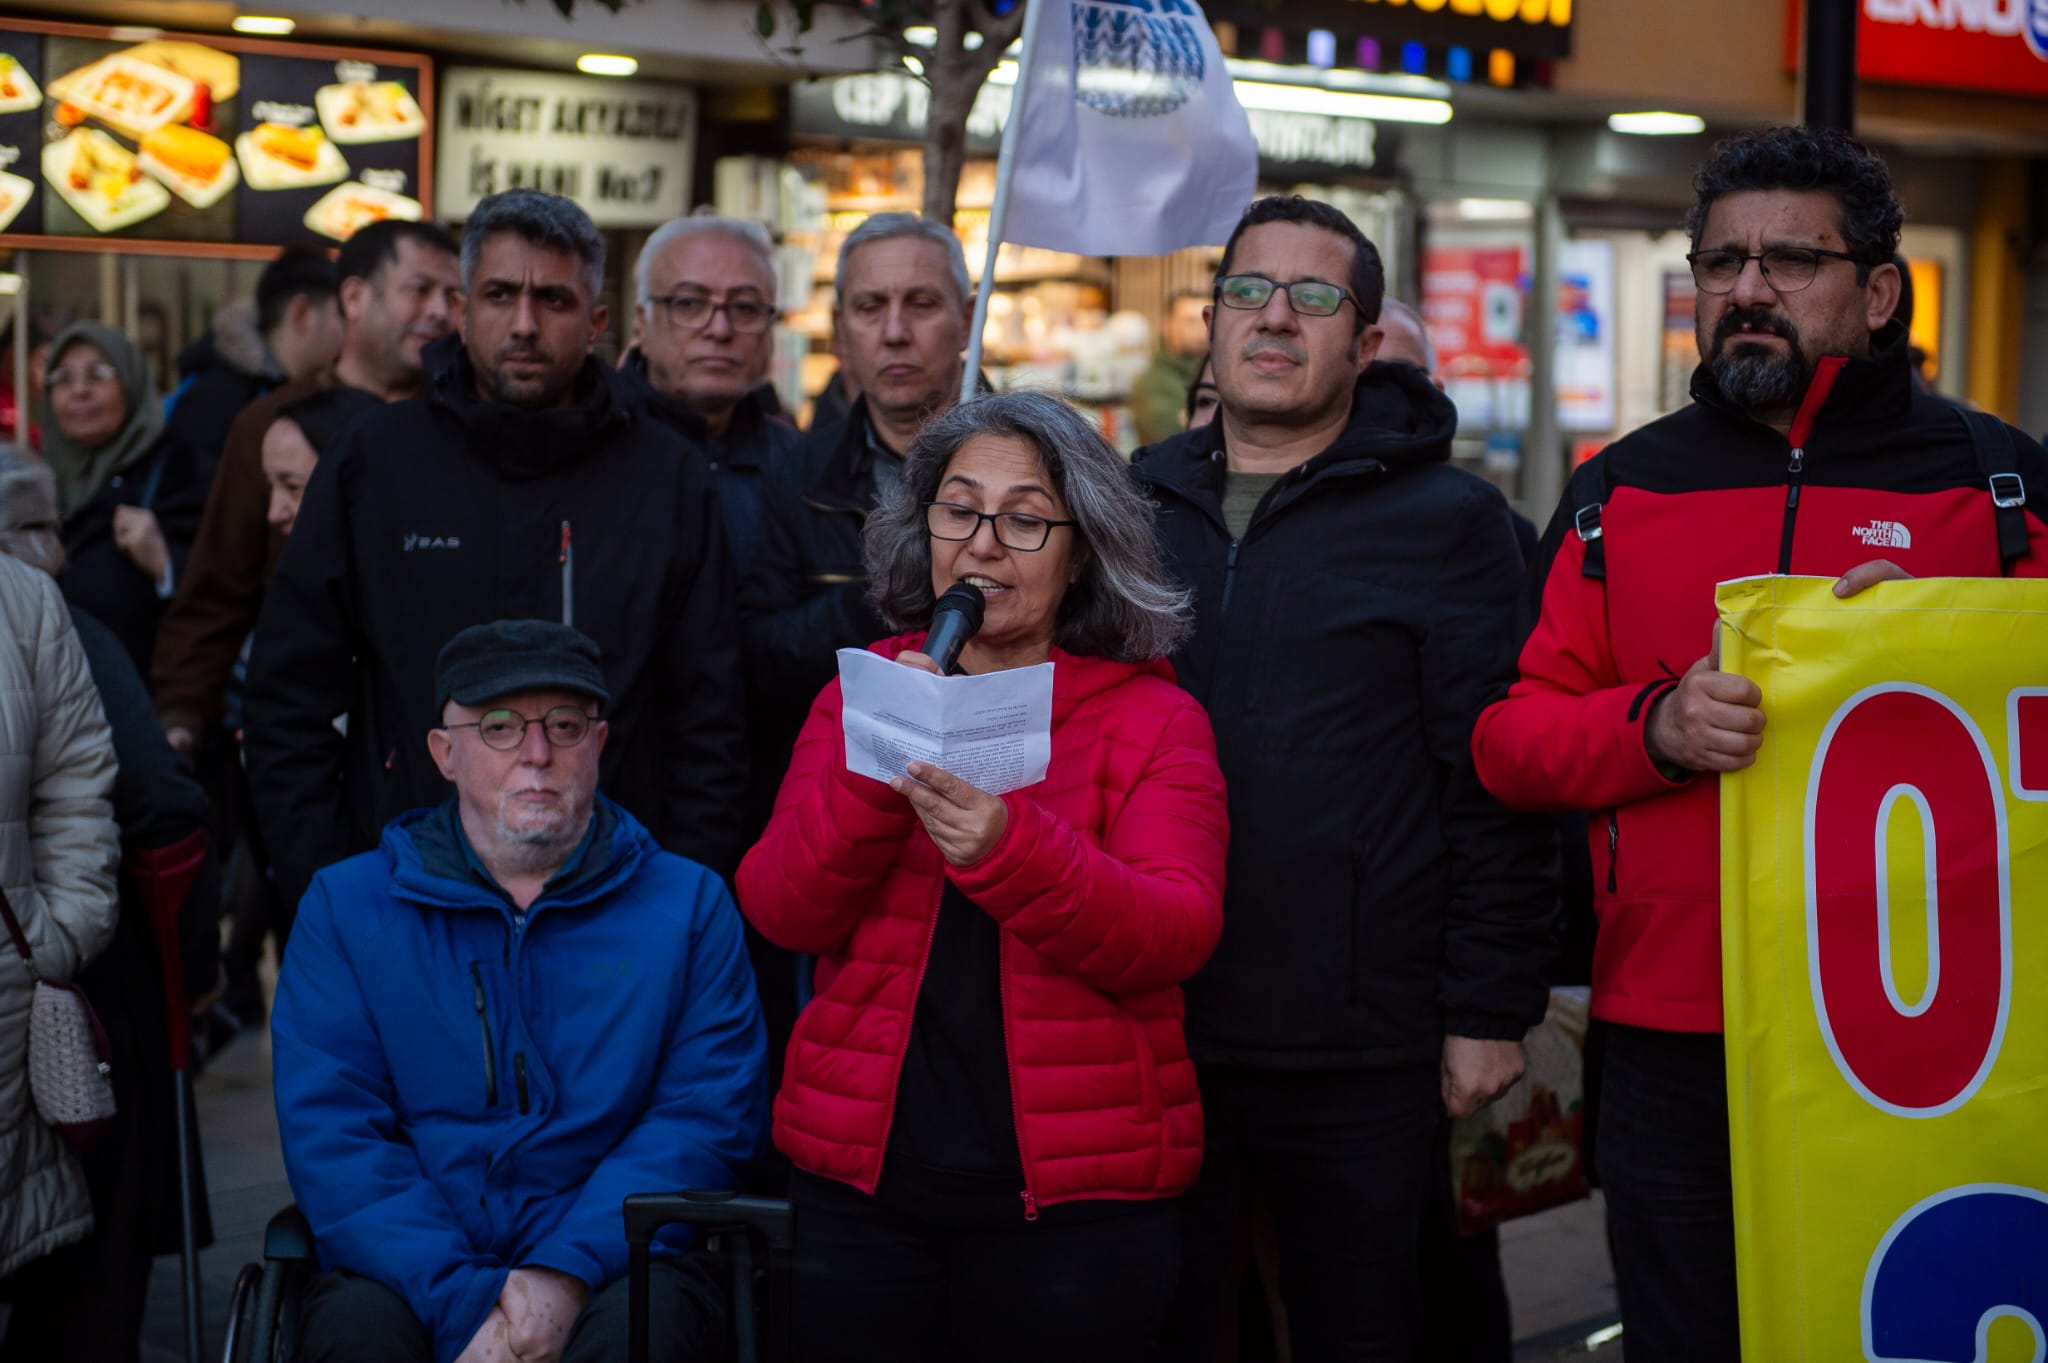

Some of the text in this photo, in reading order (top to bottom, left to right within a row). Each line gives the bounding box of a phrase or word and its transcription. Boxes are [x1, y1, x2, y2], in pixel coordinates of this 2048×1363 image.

[1870, 519, 1893, 530] THE
[1852, 526, 1892, 538] NORTH
[1862, 535, 1891, 547] FACE
